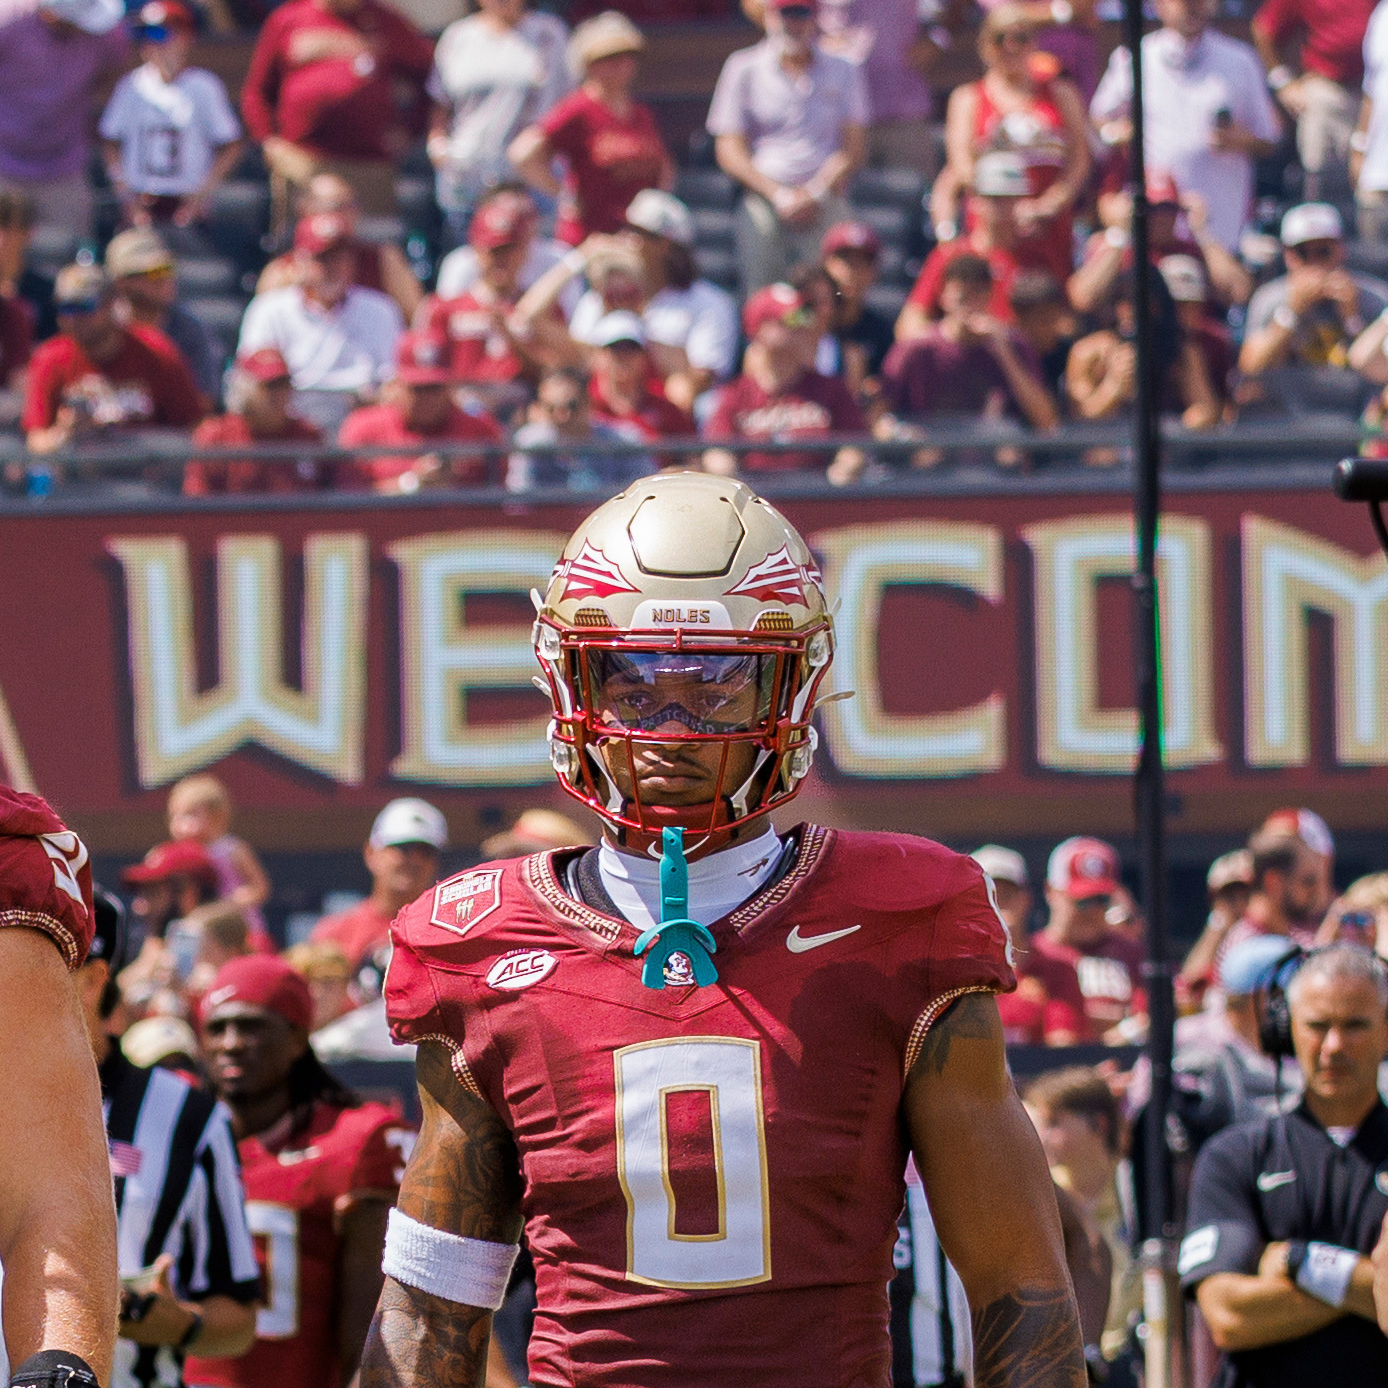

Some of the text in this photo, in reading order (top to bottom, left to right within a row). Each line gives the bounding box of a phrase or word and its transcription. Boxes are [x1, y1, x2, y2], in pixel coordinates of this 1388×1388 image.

[107, 511, 1388, 788] WECOM
[651, 608, 711, 624] NOLES
[495, 952, 546, 981] ACC
[613, 1035, 773, 1290] 0
